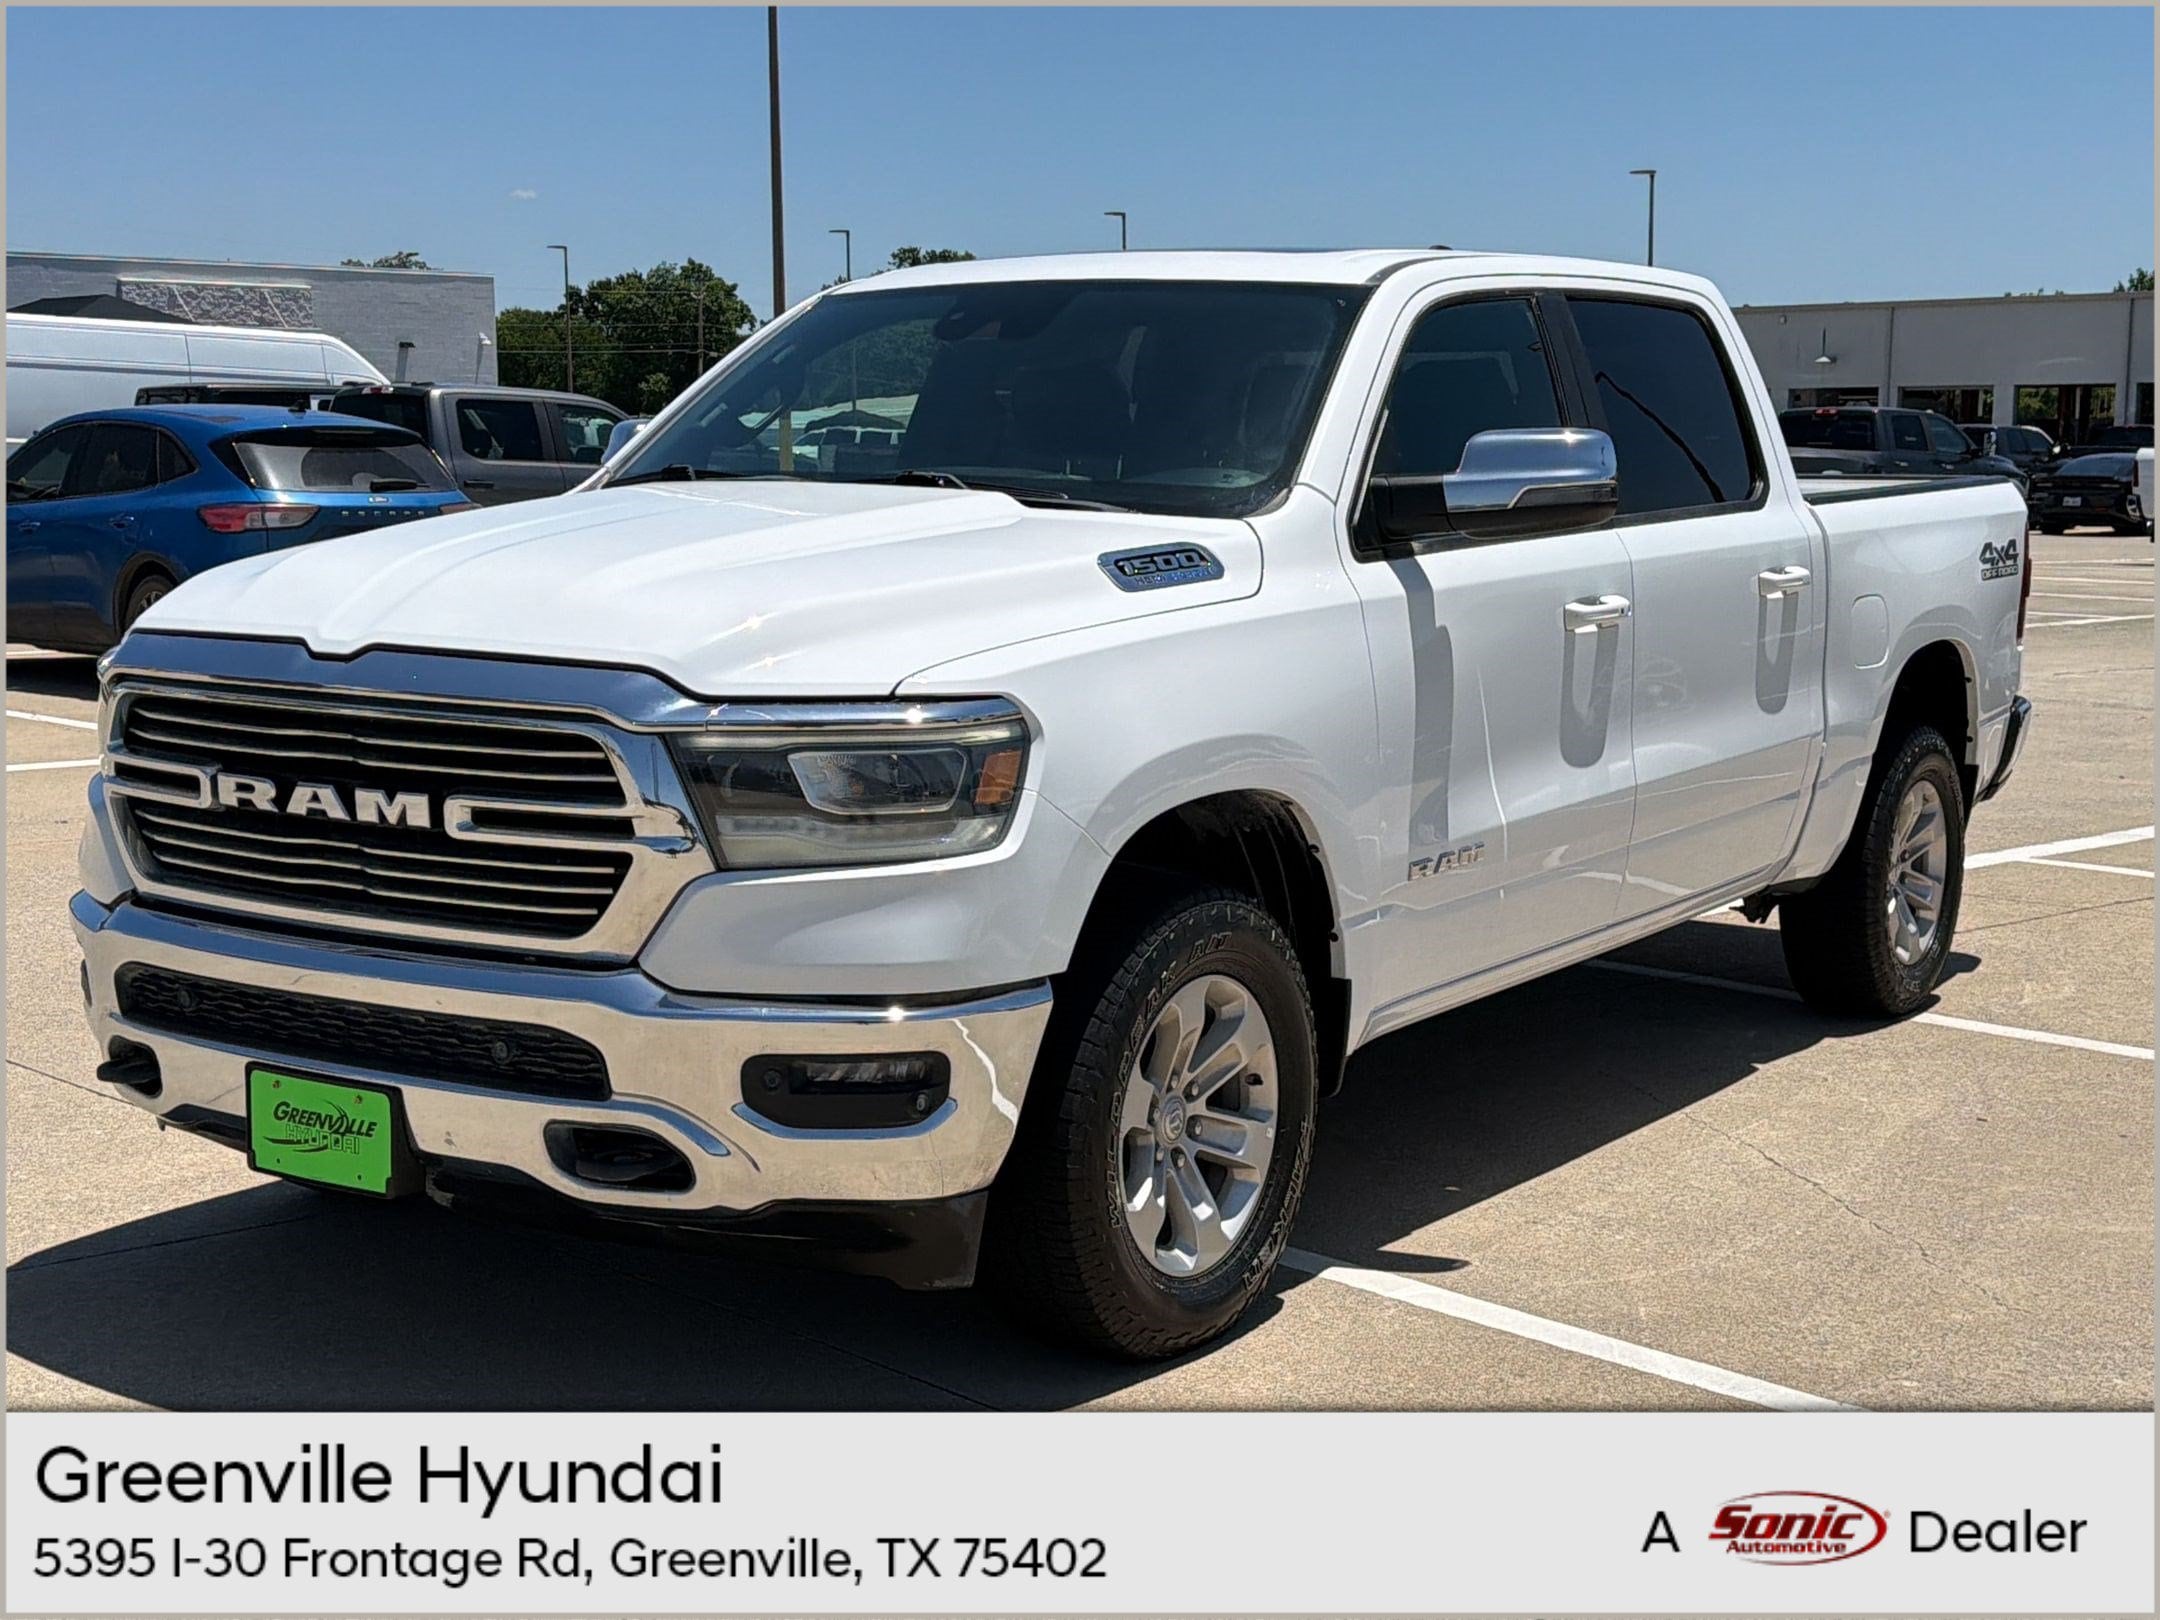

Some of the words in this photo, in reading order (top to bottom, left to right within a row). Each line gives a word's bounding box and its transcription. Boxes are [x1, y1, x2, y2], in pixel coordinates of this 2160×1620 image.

[1116, 551, 1202, 577] 1500
[1982, 568, 1998, 580] OFF
[217, 772, 431, 829] RAM
[1407, 841, 1485, 882] RAM
[273, 1100, 378, 1138] GREENVILLE
[285, 1122, 360, 1155] HYUNDAI
